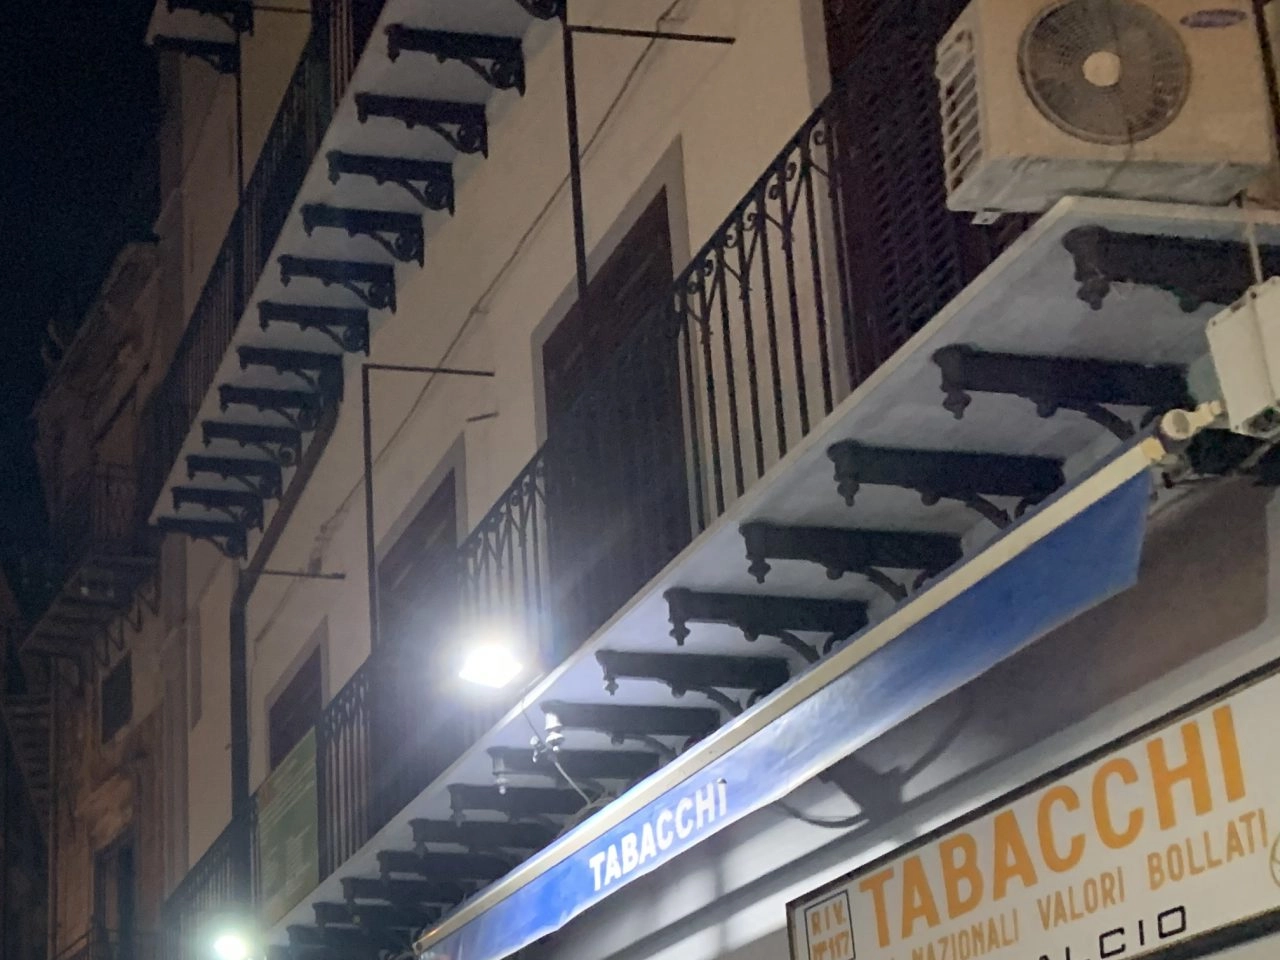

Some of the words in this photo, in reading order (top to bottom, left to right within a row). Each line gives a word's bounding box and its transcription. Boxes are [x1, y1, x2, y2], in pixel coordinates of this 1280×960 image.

[589, 780, 727, 891] TABACCHI
[859, 704, 1246, 948] TABACCHI
[1037, 865, 1125, 931] VALORI
[1147, 808, 1268, 891] BOLLATI
